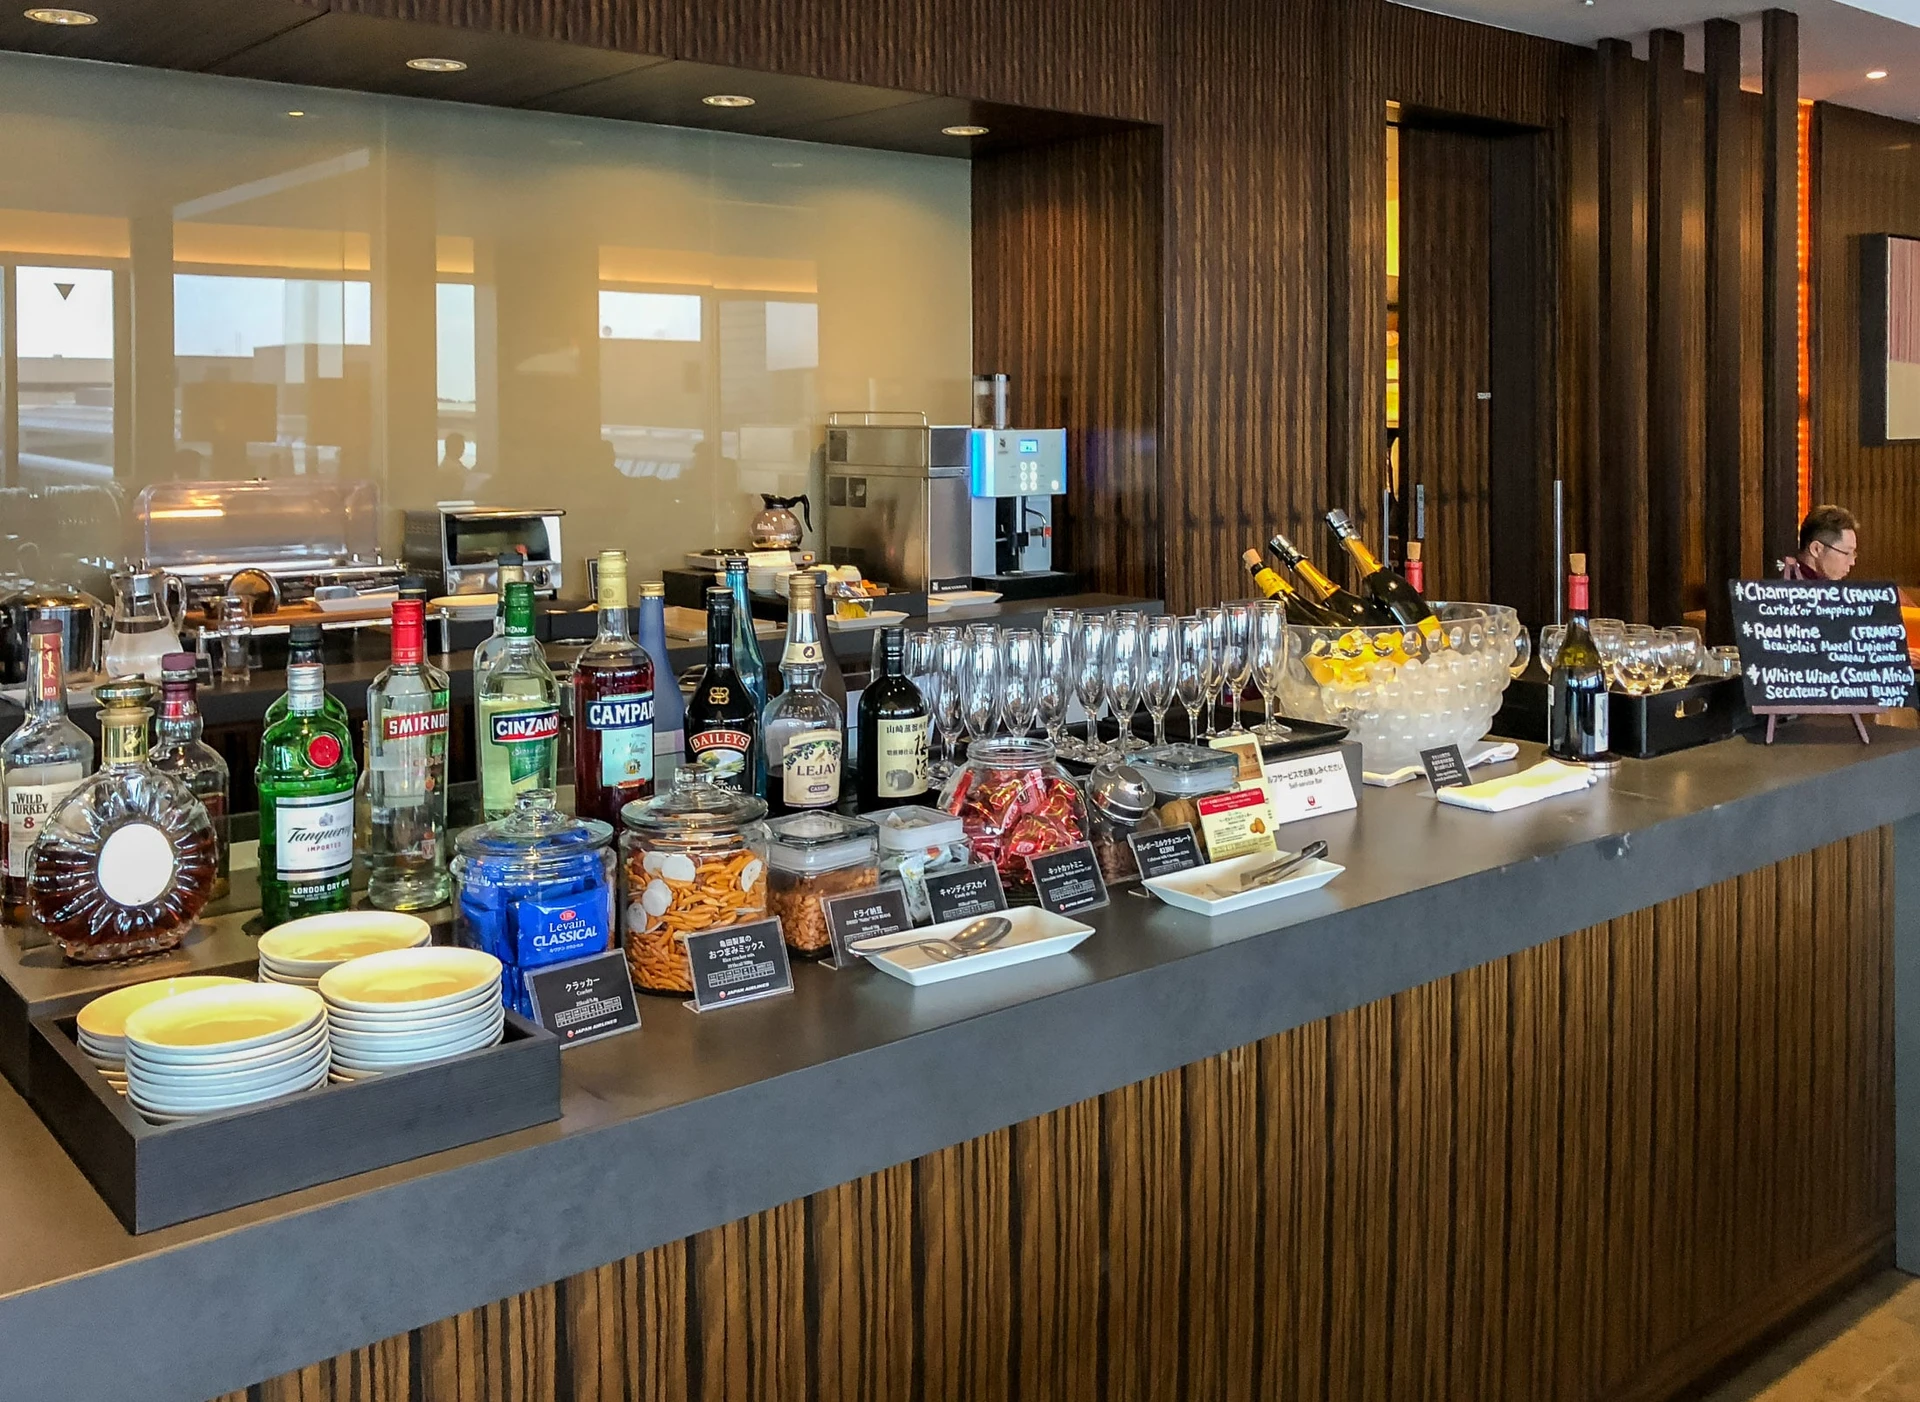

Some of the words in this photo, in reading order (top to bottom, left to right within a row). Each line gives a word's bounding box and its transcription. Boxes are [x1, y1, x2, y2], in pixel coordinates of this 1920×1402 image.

[1745, 582, 1840, 607] Champagne
[1857, 605, 1873, 616] NV
[1754, 622, 1782, 640] Red
[1783, 624, 1821, 639] Wine
[1762, 667, 1804, 685] White
[1806, 668, 1839, 684] Wine
[1841, 666, 1881, 686] (South
[1882, 666, 1915, 686] Africa)
[1766, 685, 1828, 700] Secateurs
[1871, 686, 1908, 699] BLANC
[1878, 698, 1904, 707] 2017
[496, 716, 558, 739] CINZANO
[693, 732, 748, 749] BAILEYS
[797, 762, 837, 776] LEJAY
[17, 793, 42, 804] WILD
[11, 802, 48, 815] TURKEY
[24, 817, 34, 829] 8
[288, 824, 351, 844] Tanqueray
[307, 842, 341, 853] IMPORTED
[293, 886, 325, 895] LONDON
[327, 883, 340, 893] DRY
[549, 918, 585, 933] Levain
[533, 925, 597, 947] CLASSICAL
[708, 941, 765, 960] おつまみミックス
[565, 978, 600, 993] クラッカー
